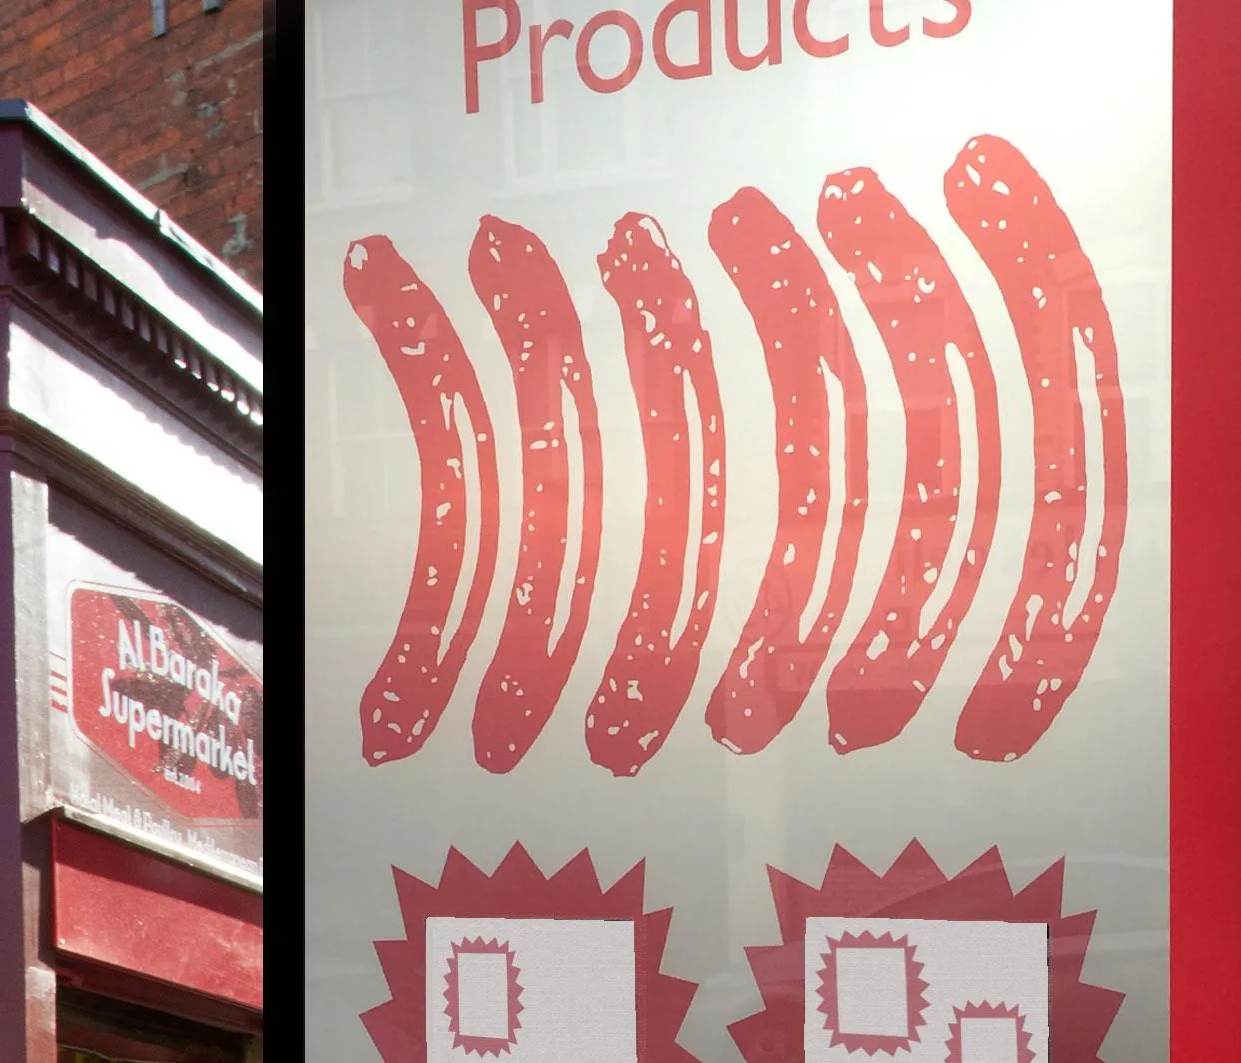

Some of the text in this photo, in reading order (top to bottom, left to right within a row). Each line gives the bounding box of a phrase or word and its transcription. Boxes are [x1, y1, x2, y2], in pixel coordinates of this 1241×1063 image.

[98, 668, 257, 786] Supermarket
[118, 618, 242, 725] Al Baraka
